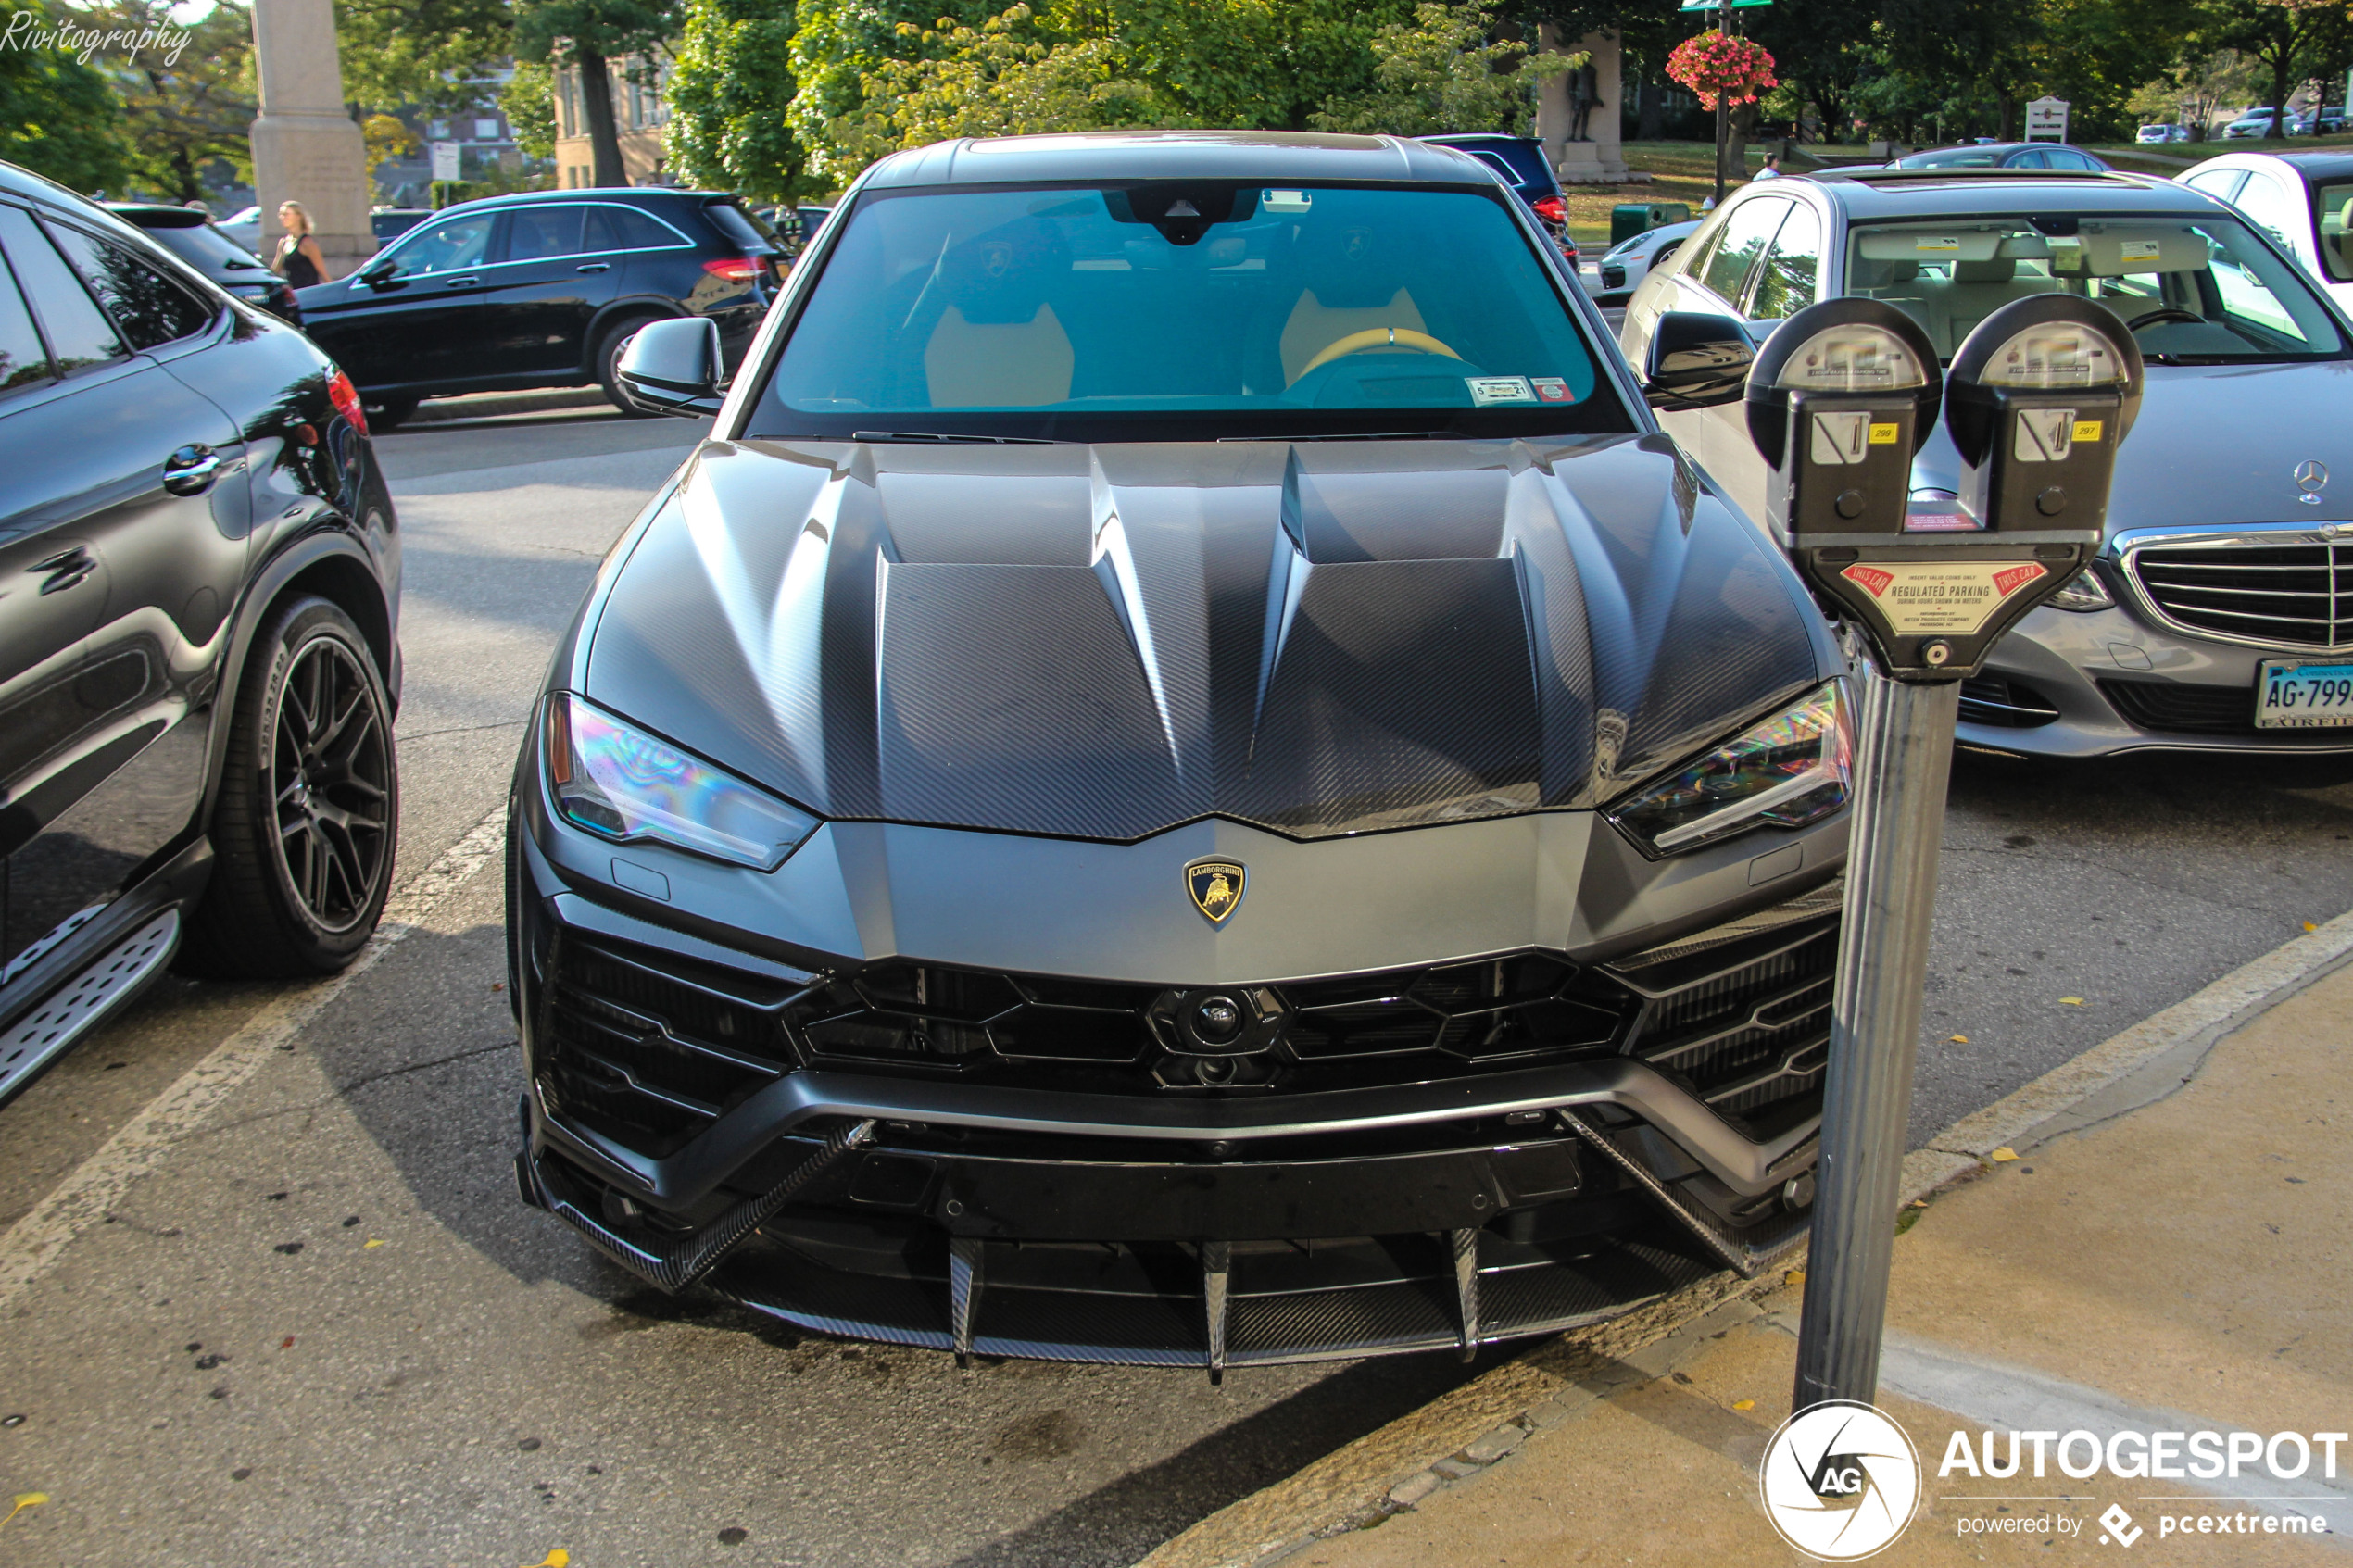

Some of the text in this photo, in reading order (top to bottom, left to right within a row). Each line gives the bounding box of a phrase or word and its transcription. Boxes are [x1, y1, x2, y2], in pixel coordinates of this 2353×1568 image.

[1874, 429, 1891, 437] 299
[2078, 427, 2095, 435] 297
[1853, 568, 1888, 593] THIS CAR
[1997, 566, 2035, 591] THIS CAR
[1891, 585, 1990, 597] REGULATED PARKING
[1192, 866, 1239, 877] LAMBORGHINI
